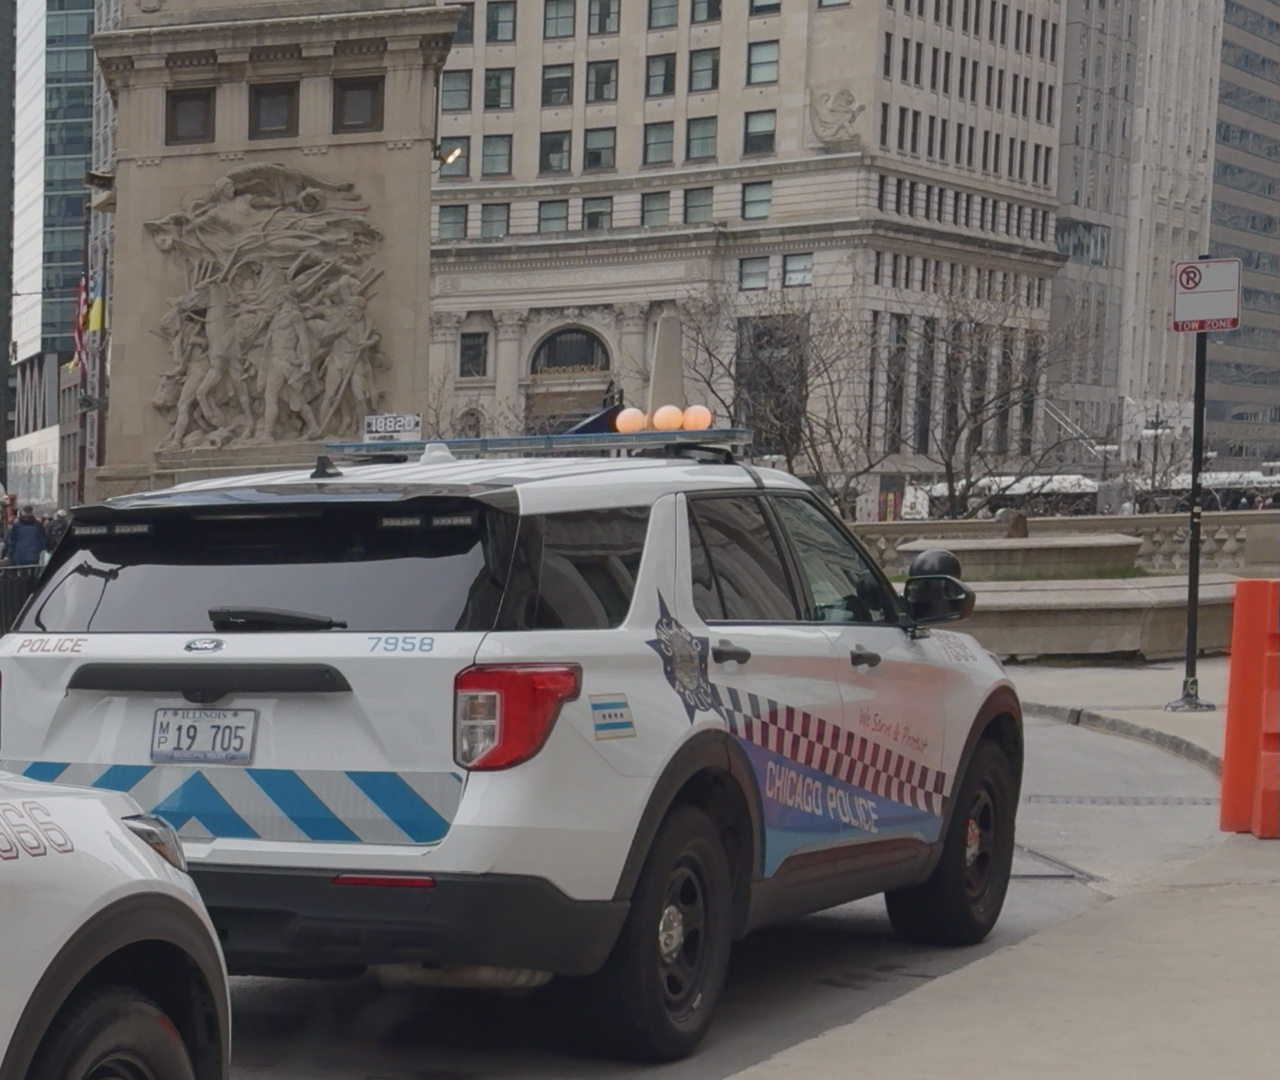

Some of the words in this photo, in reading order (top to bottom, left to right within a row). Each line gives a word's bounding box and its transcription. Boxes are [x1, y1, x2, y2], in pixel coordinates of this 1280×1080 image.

[1177, 321, 1199, 331] TOW
[1205, 319, 1234, 330] ZONE
[17, 638, 88, 653] POLICE
[368, 636, 435, 652] 7958
[181, 710, 228, 719] ILLINOIS
[173, 724, 198, 751] 19
[210, 725, 246, 752] 705
[766, 760, 824, 816] CHICAGO
[827, 786, 879, 834] POLICE
